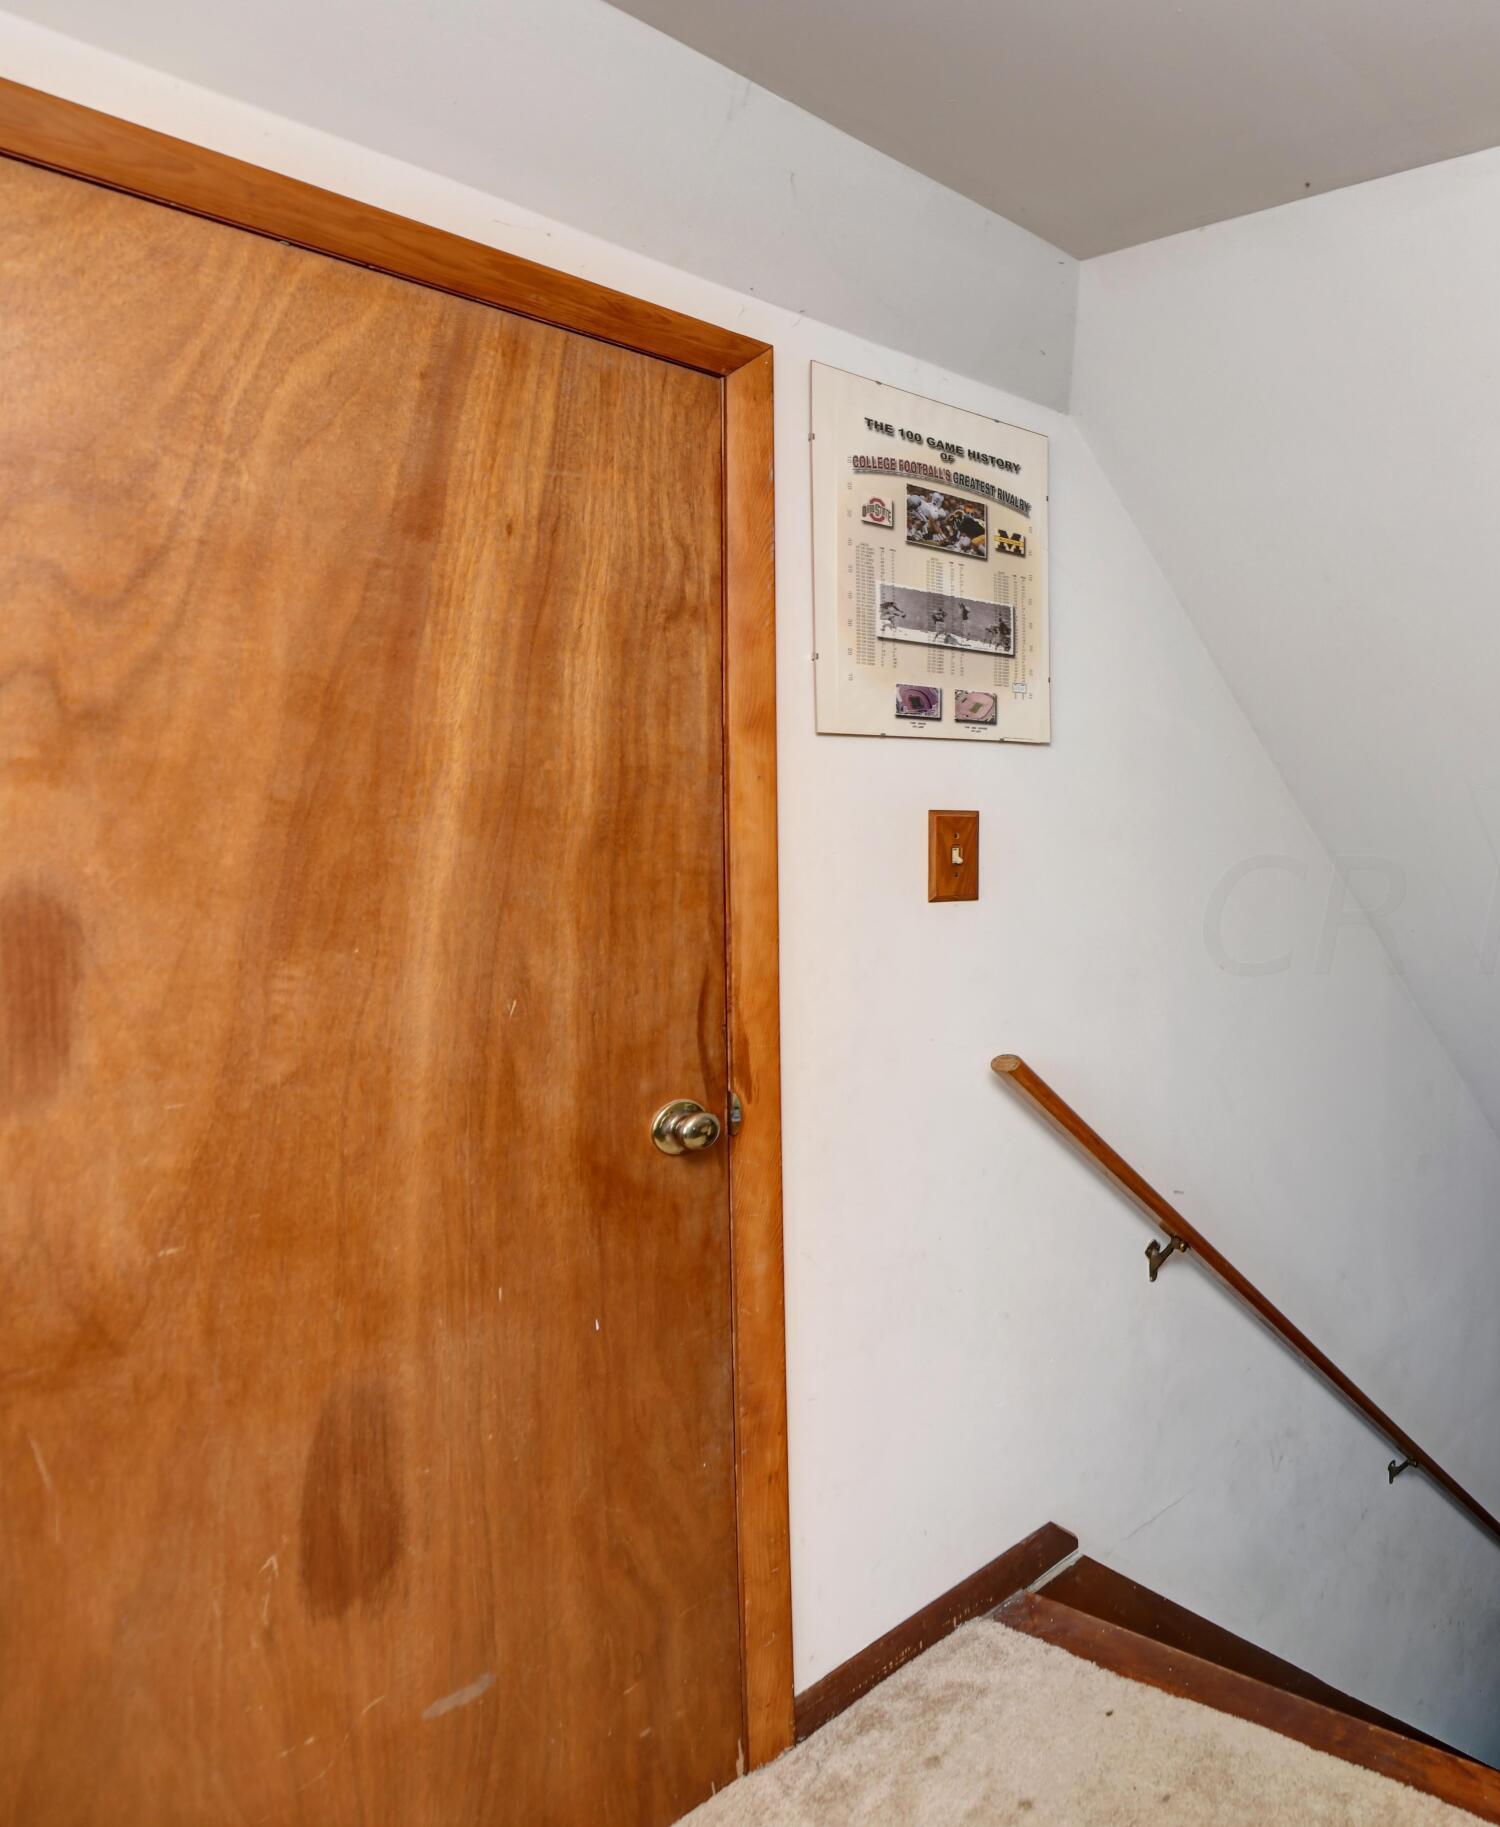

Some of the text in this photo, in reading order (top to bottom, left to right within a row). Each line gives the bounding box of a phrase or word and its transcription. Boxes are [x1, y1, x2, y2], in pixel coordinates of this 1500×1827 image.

[864, 417, 1021, 474] THE 100 GAME HISTORY
[940, 452, 955, 463] OF
[852, 455, 1031, 512] COLLEGE FOOTBALL'S GREATEST RIVALRY
